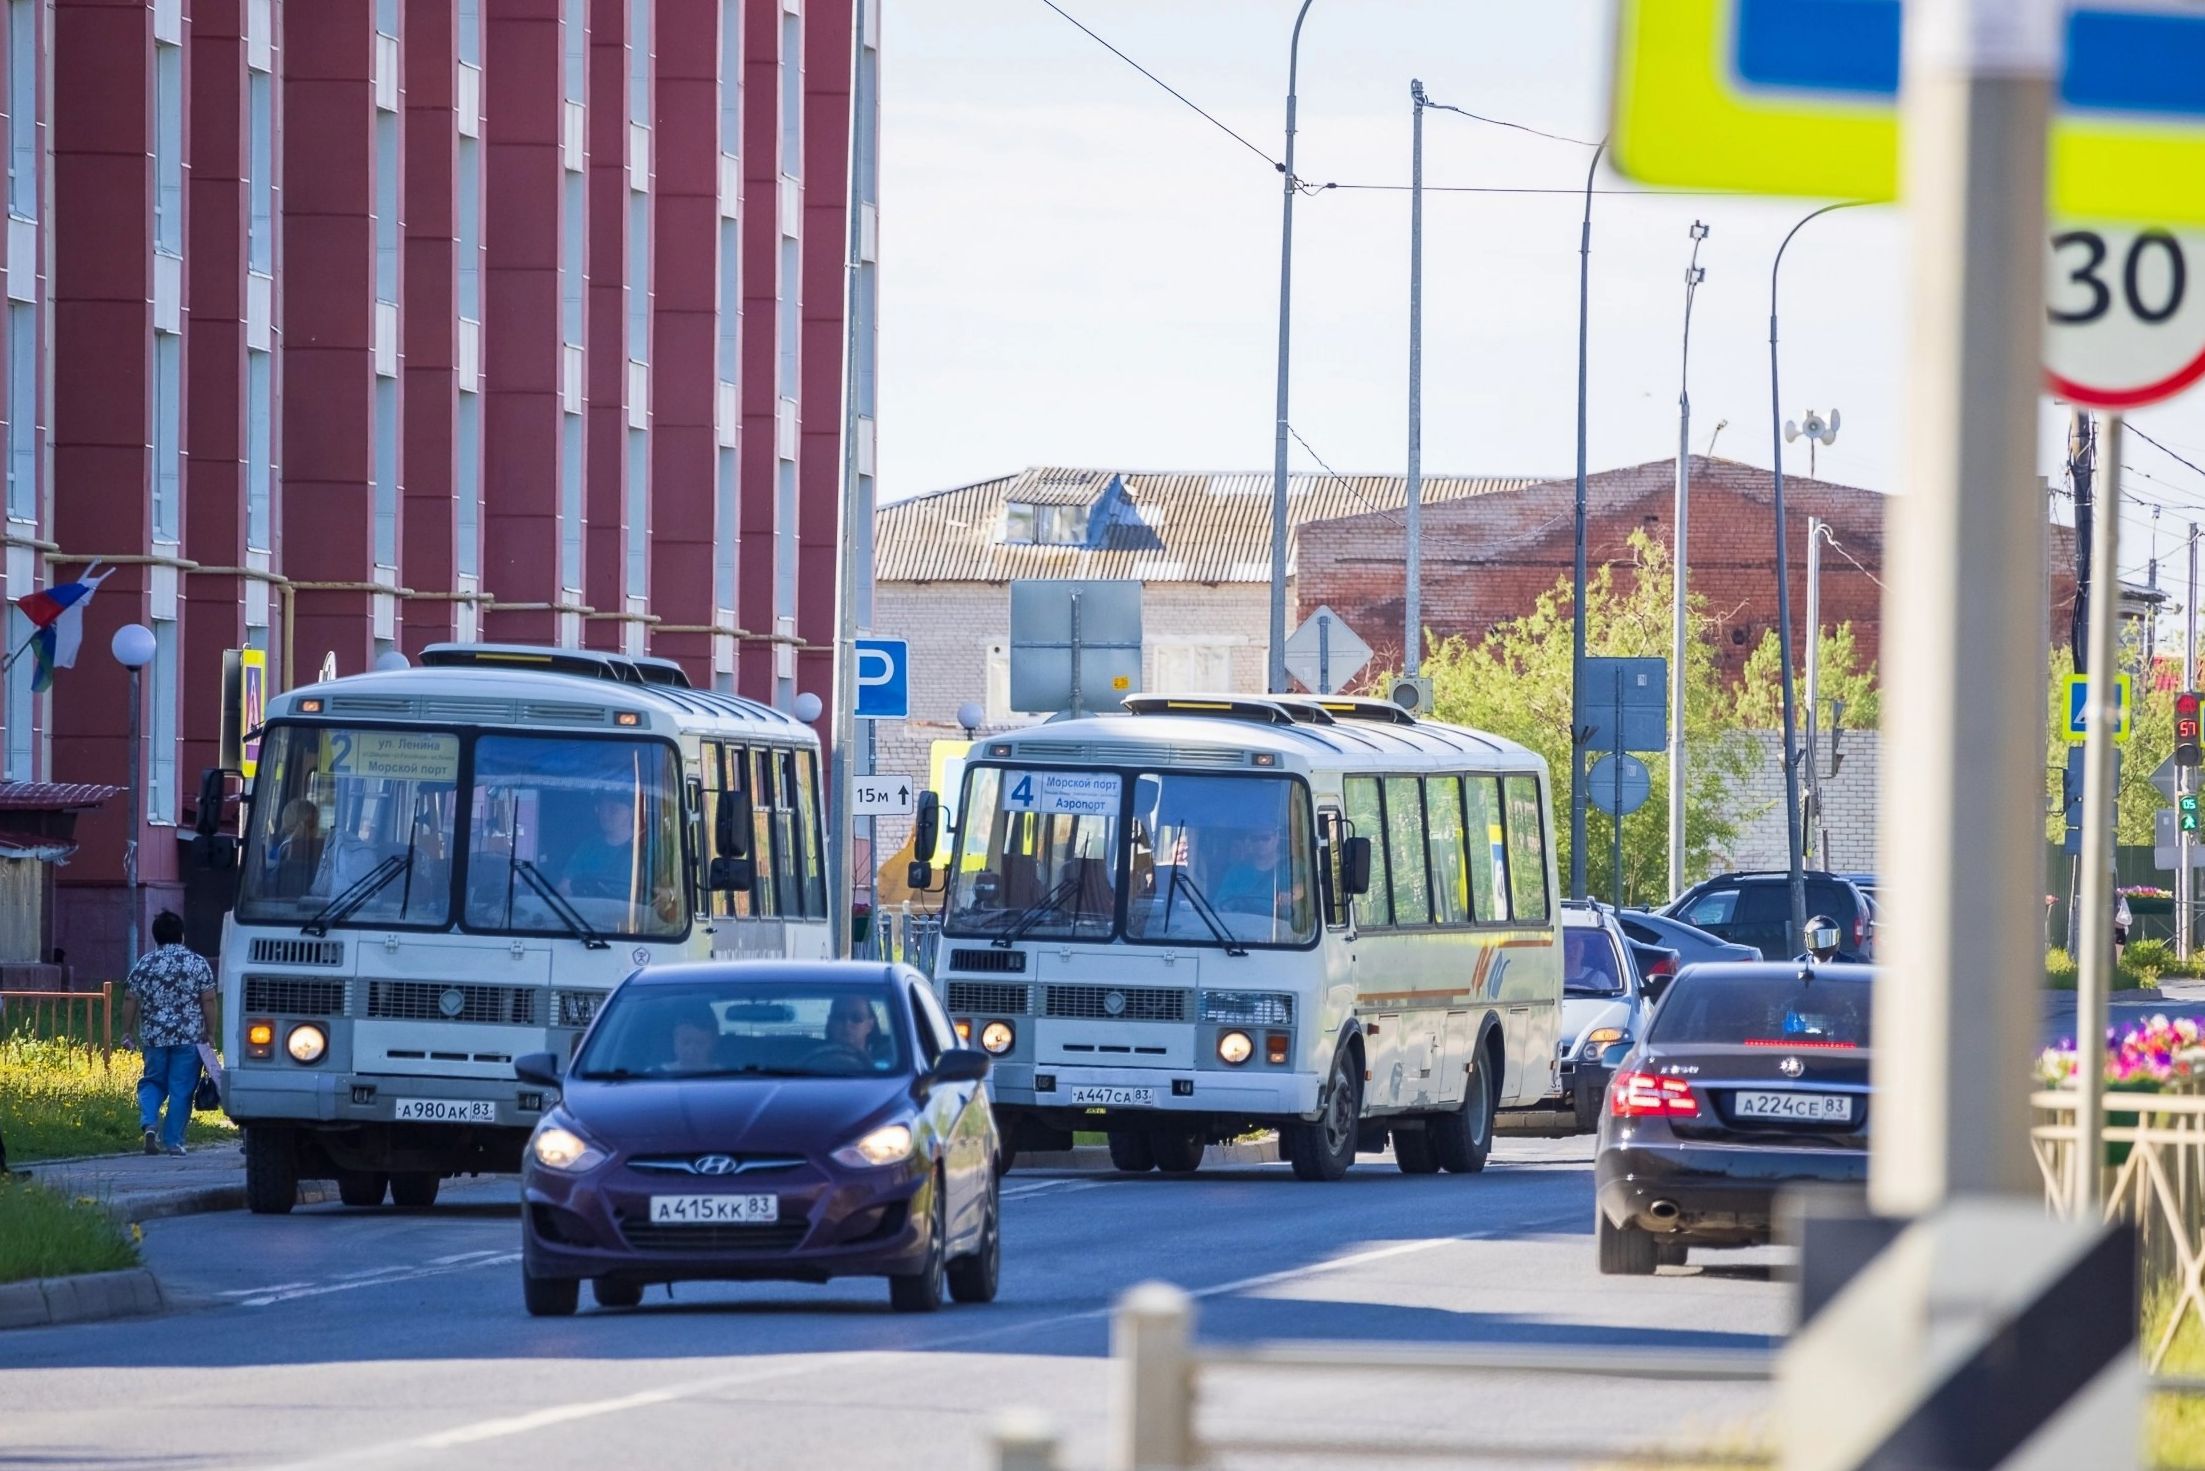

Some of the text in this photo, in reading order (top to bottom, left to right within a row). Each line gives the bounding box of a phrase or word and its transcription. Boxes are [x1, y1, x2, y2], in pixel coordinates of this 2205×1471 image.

[2047, 228, 2186, 326] 30
[855, 648, 895, 710] P
[2180, 722, 2196, 737] 57
[328, 734, 352, 773] 2
[398, 739, 440, 752] Ленина
[368, 761, 448, 777] Морской порт
[1011, 774, 1034, 808] 4
[1046, 776, 1117, 791] Морской порт
[1056, 798, 1105, 813] Аэропорт
